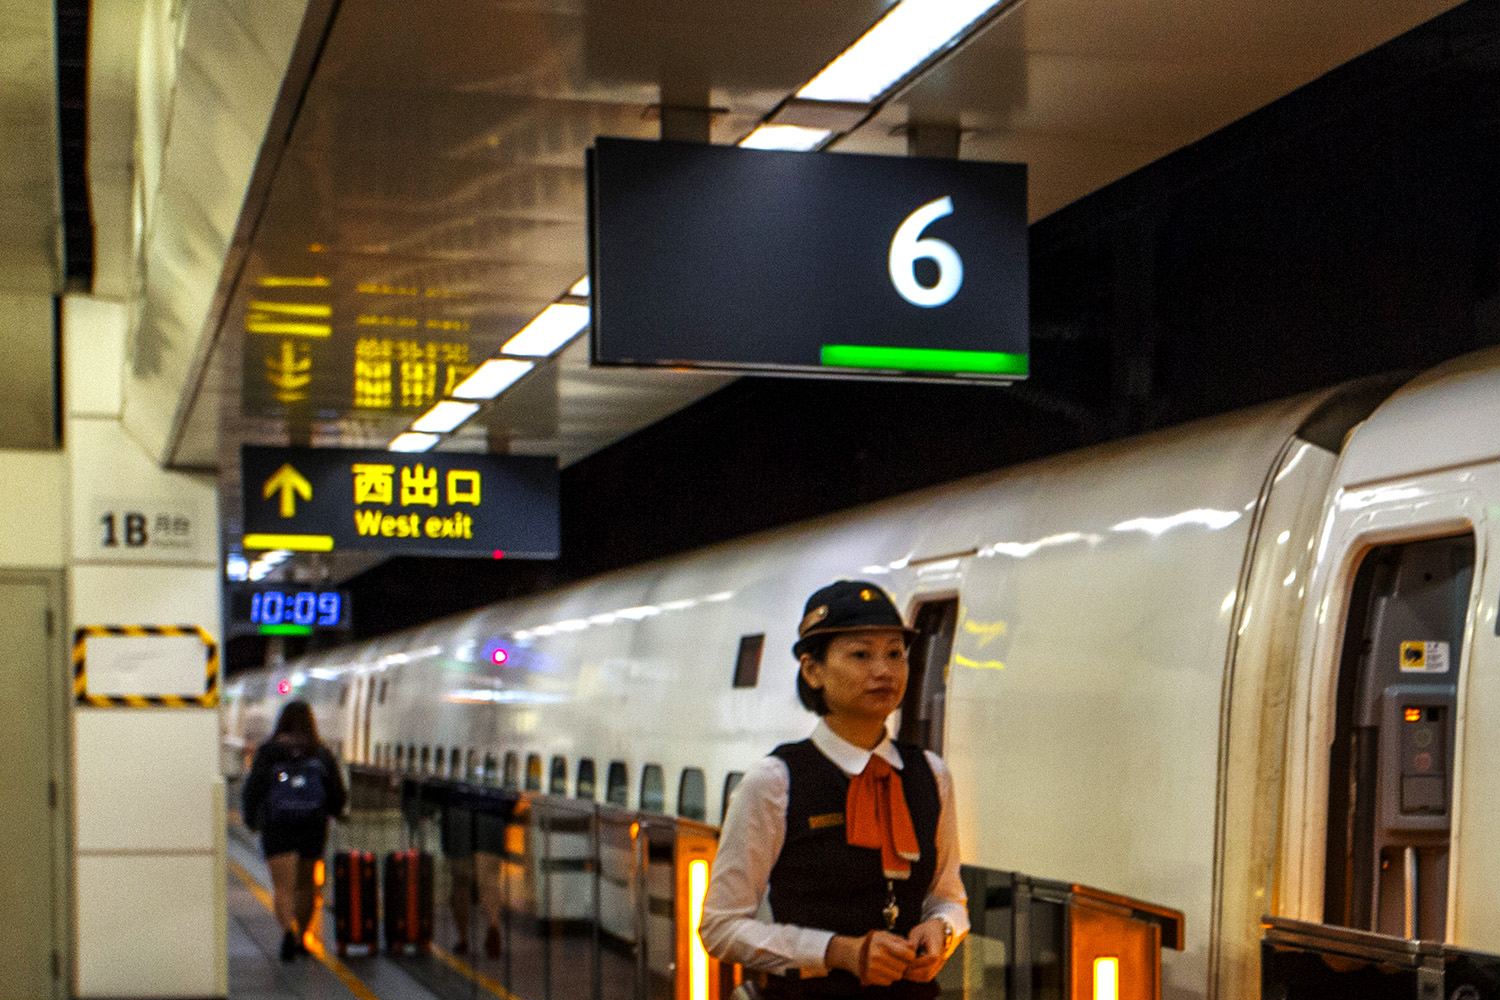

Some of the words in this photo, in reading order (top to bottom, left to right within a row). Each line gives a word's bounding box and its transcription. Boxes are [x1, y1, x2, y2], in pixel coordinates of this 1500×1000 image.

[888, 195, 964, 308] 6
[351, 463, 481, 507] 西出口
[101, 512, 149, 548] 1B
[354, 509, 420, 538] West
[424, 511, 473, 539] exit
[251, 591, 342, 625] 10:09
